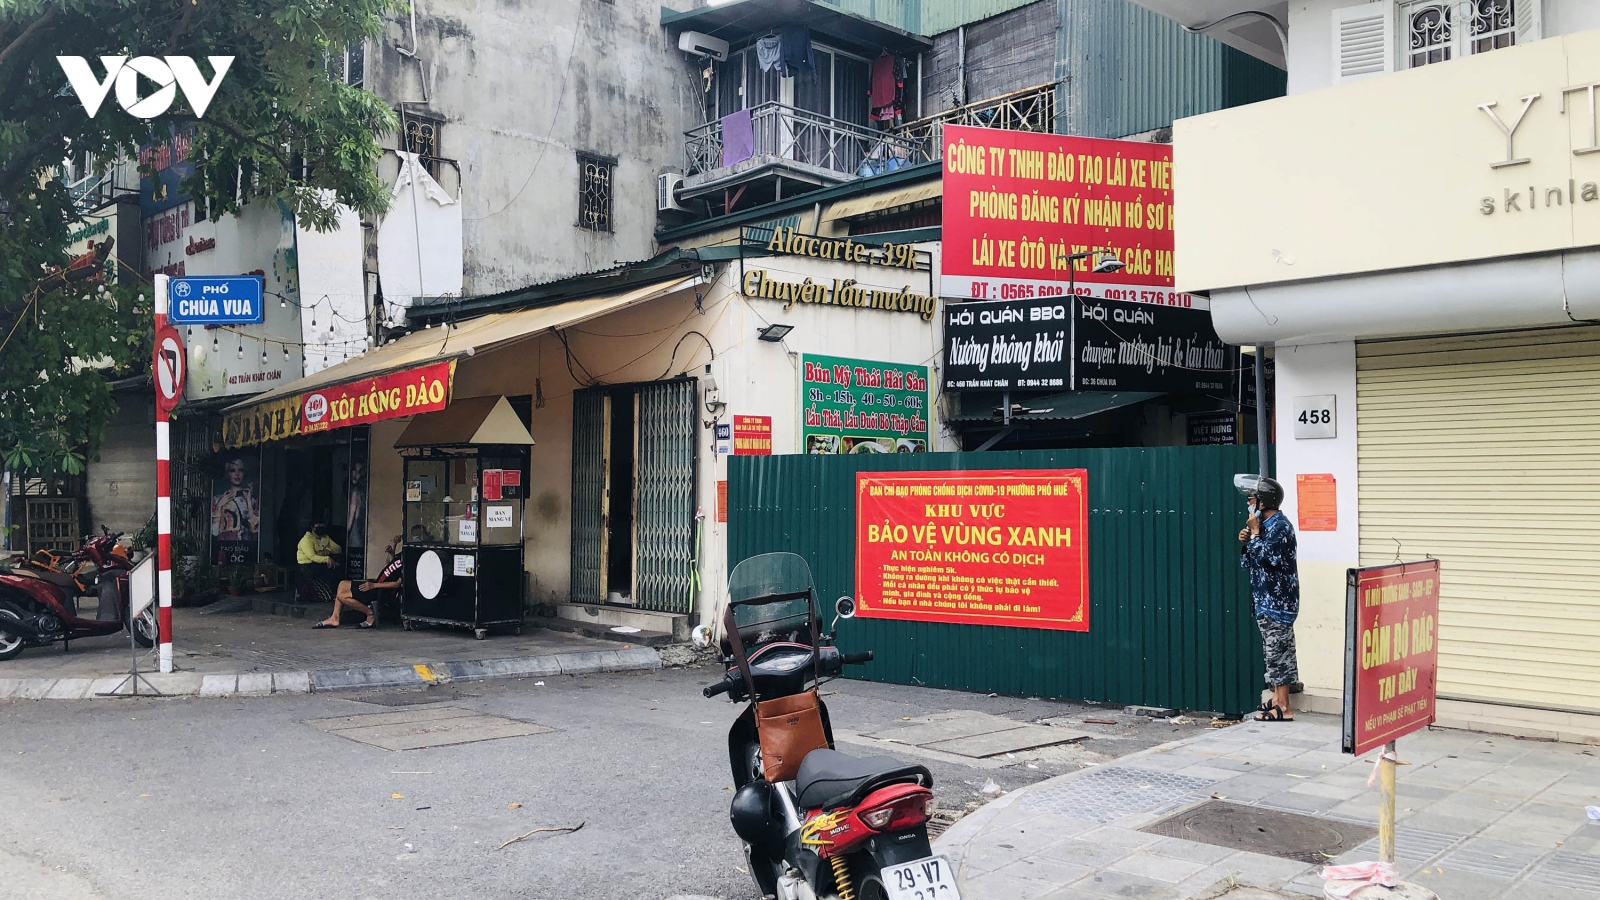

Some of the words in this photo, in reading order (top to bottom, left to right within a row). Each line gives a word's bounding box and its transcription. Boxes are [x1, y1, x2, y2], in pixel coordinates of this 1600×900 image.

[947, 138, 985, 176] CÔNG
[989, 147, 1005, 177] TY
[1009, 148, 1043, 180] TNHH
[1047, 147, 1074, 183] ĐÀO
[1078, 154, 1103, 191] TẠO
[1106, 151, 1127, 186] LÁI
[1130, 158, 1146, 188] XE
[969, 184, 1016, 220] PHÒNG
[1021, 189, 1059, 223] ĐĂNG
[1062, 193, 1080, 224] KÝ
[1084, 196, 1121, 232] NHẬN
[1125, 193, 1143, 229] HỒ
[1146, 200, 1164, 231] SƠ
[768, 226, 865, 263] Alacarte
[880, 241, 919, 270] 39k
[972, 233, 994, 266] LÁI
[998, 239, 1015, 268] XE
[1019, 236, 1045, 269] ÔTÔ
[1049, 238, 1067, 271] VÀ
[1071, 245, 1088, 272] XE
[1125, 241, 1151, 275] CÁC
[203, 282, 229, 294] PHỐ
[743, 269, 829, 312] Chuyên
[871, 285, 937, 321] nướng
[971, 282, 988, 299] ĐT
[1001, 284, 1034, 300] 0565
[1140, 290, 1165, 305] 576
[1167, 292, 1192, 308] 810
[179, 296, 219, 316] CHÙA
[223, 299, 252, 316] VUA
[980, 306, 1024, 325] QUÁN
[1030, 305, 1065, 321] BBQ
[1113, 307, 1154, 325] QUÁN
[949, 335, 990, 373] Nướng
[991, 333, 1032, 371] không
[1033, 330, 1065, 363] khói
[1081, 340, 1116, 370] chuyên:
[1118, 333, 1155, 375] nướng
[1174, 337, 1183, 368] &
[1185, 332, 1202, 369] lẩu
[1203, 340, 1224, 370] thái
[252, 371, 266, 382] KHÁT
[267, 369, 282, 381] CHÂN
[804, 362, 831, 383] Bún
[833, 365, 852, 389] Mỳ
[855, 367, 881, 388] Thái
[883, 368, 903, 390] Hải
[905, 370, 926, 392] Sản
[330, 392, 355, 423] XÔI
[357, 381, 401, 417] HỒNG
[405, 375, 445, 409] ĐÀO
[809, 388, 824, 402] 8h
[862, 392, 874, 405] 40
[883, 394, 896, 407] 50
[904, 395, 923, 408] 60k
[805, 403, 821, 427] Lẩu
[822, 408, 843, 432] Thái,
[891, 413, 909, 436] Thập
[1298, 409, 1331, 425] 458
[1193, 425, 1209, 436] VIỆT
[869, 485, 883, 496] BAN
[884, 482, 895, 496] CHỈ
[895, 485, 909, 498] ĐẠO
[910, 482, 932, 496] PHÒNG
[933, 481, 955, 496] CHỐNG
[957, 485, 973, 498] DỊCH
[974, 485, 1005, 496] COVID-19
[1006, 482, 1035, 496] PHƯỜNG
[1037, 480, 1052, 496] PHỐ
[1053, 481, 1068, 496] HUẾ
[925, 504, 963, 518] KHU
[968, 503, 1005, 520] VỰC
[868, 519, 909, 543] BẢO
[911, 522, 937, 549] VỆ
[940, 521, 1001, 546] VÙNG
[1007, 526, 1071, 548] XANH
[882, 564, 899, 573] Thực
[900, 565, 916, 573] hiện
[917, 566, 944, 574] nghiêm
[945, 566, 957, 574] 5k.
[890, 550, 907, 561] AN
[909, 548, 942, 562] TOÀN
[944, 549, 989, 564] KHÔNG
[991, 551, 1009, 565] CÓ
[1012, 553, 1045, 568] DỊCH
[882, 572, 904, 581] Không
[914, 574, 937, 582] đường
[938, 574, 950, 582] khi
[951, 575, 974, 583] không
[987, 577, 1003, 585] việc
[1005, 577, 1020, 586] thật
[897, 581, 907, 589] cá
[908, 582, 926, 590] nhân
[941, 583, 958, 591] phải
[977, 585, 994, 593] thức
[1005, 586, 1019, 594] bảo
[1021, 587, 1031, 596] vệ
[882, 597, 897, 605] Nếu
[898, 598, 911, 606] bạn
[969, 602, 992, 611] không
[994, 603, 1011, 612] phải
[1022, 605, 1041, 613] làm!
[903, 590, 914, 598] gia
[943, 592, 961, 600] cộng
[1365, 585, 1371, 608] VÌ
[1371, 583, 1380, 607] MÔI
[1381, 581, 1398, 605] TRƯỜNG
[1362, 614, 1392, 671] CẤM
[1393, 606, 1409, 659] ĐỔ
[1411, 609, 1433, 655] RÁC
[1378, 674, 1396, 704] TẠI
[1398, 666, 1418, 695] ĐÂY
[1365, 713, 1377, 732] NẾU
[1382, 710, 1397, 725] PHẠM
[1397, 704, 1404, 719] SẼ
[1404, 702, 1416, 716] PHẠT
[1416, 695, 1428, 711] TIỀN
[893, 860, 940, 891] 29-V7
